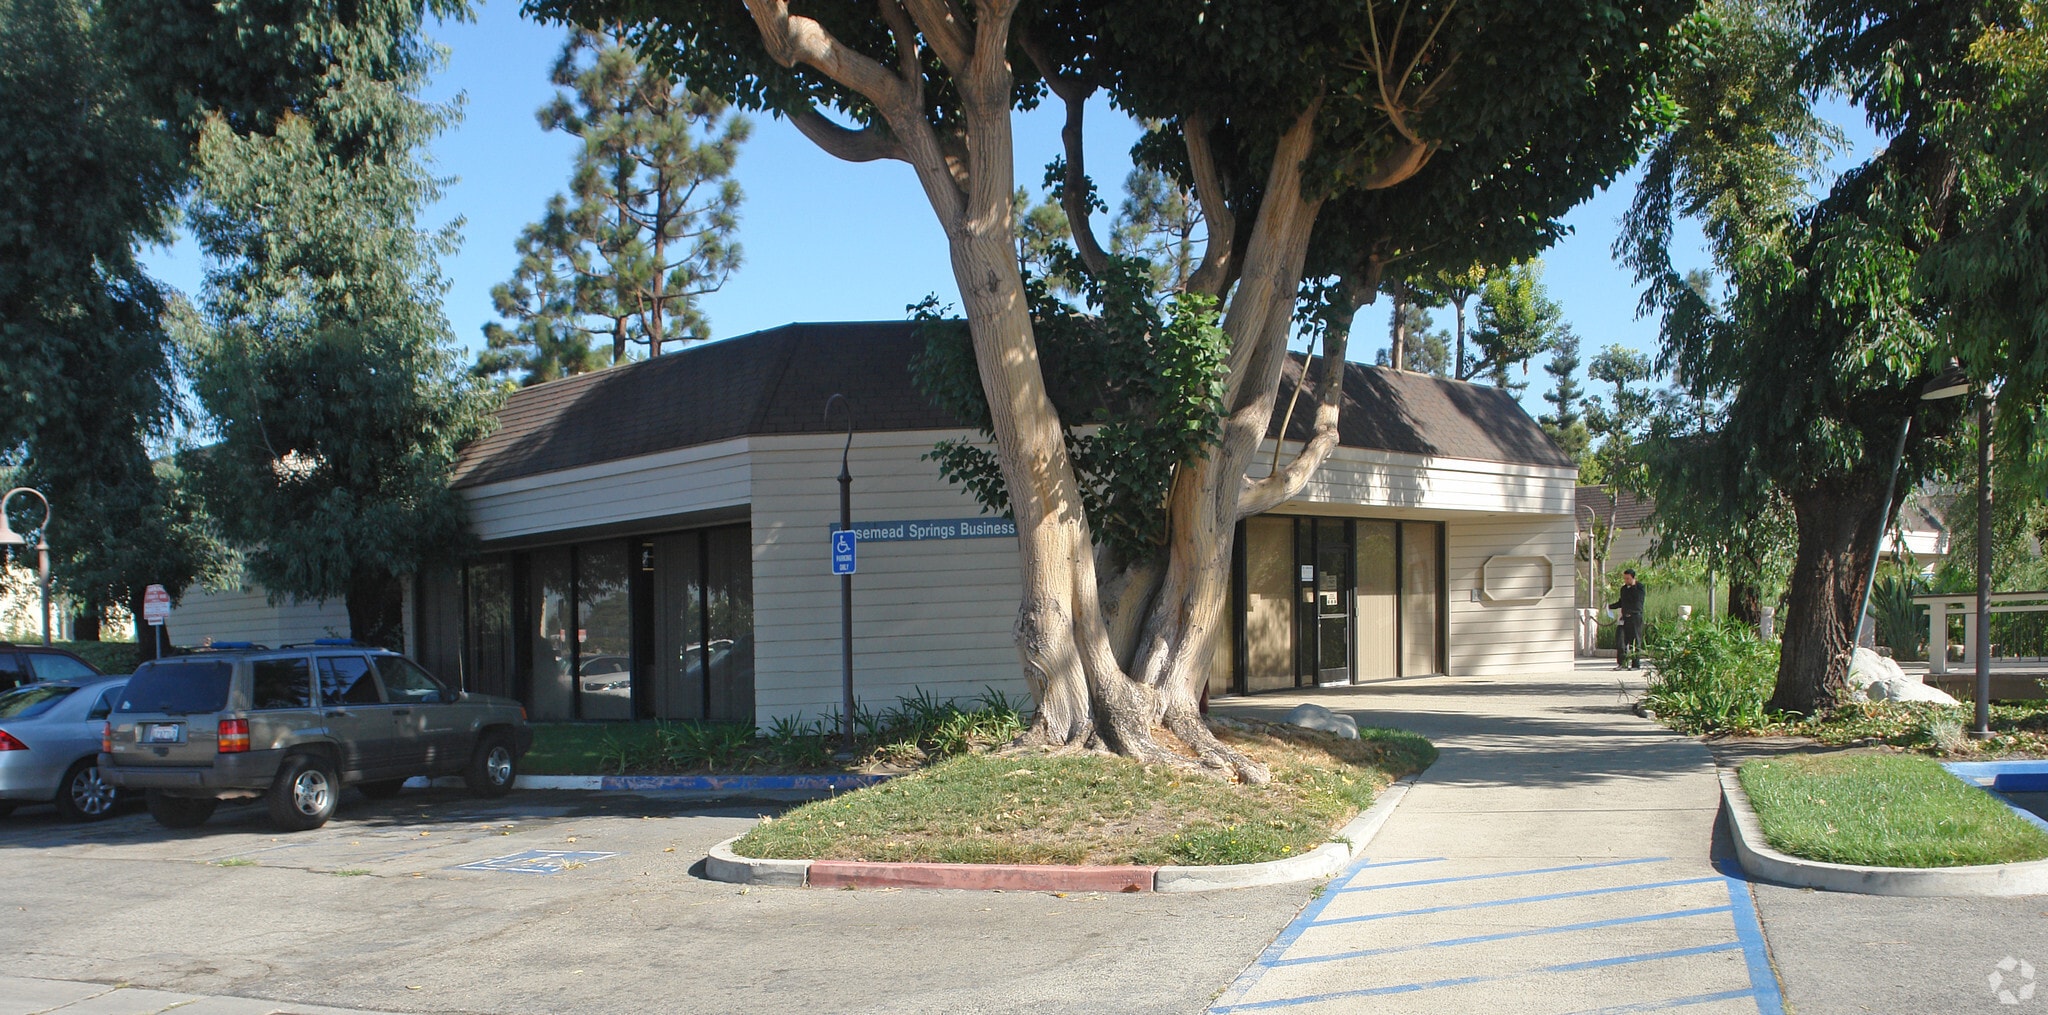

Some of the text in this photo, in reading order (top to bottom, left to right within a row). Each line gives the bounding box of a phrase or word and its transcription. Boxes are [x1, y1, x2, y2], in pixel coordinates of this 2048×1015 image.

[840, 521, 1016, 540] semead Springs Business
